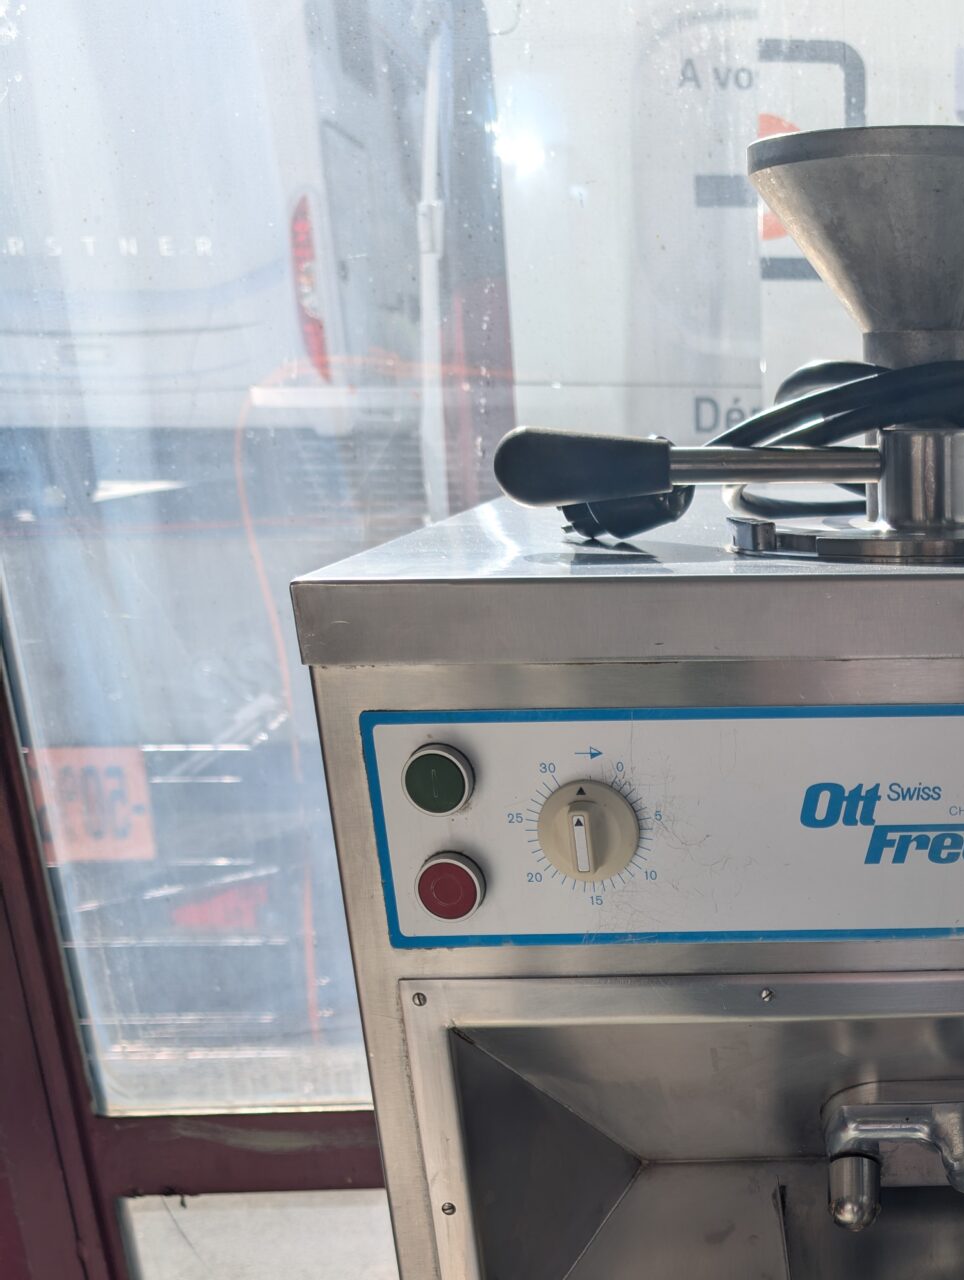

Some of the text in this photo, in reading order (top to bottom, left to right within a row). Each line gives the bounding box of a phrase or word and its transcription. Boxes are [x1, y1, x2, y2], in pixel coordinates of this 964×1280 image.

[539, 762, 556, 774] 30
[616, 761, 624, 773] 0
[800, 782, 942, 829] Ott Swiss
[507, 813, 523, 824] 25
[654, 810, 663, 821] 5
[527, 872, 543, 883] 20
[644, 870, 657, 881] 10
[590, 896, 604, 906] 15
